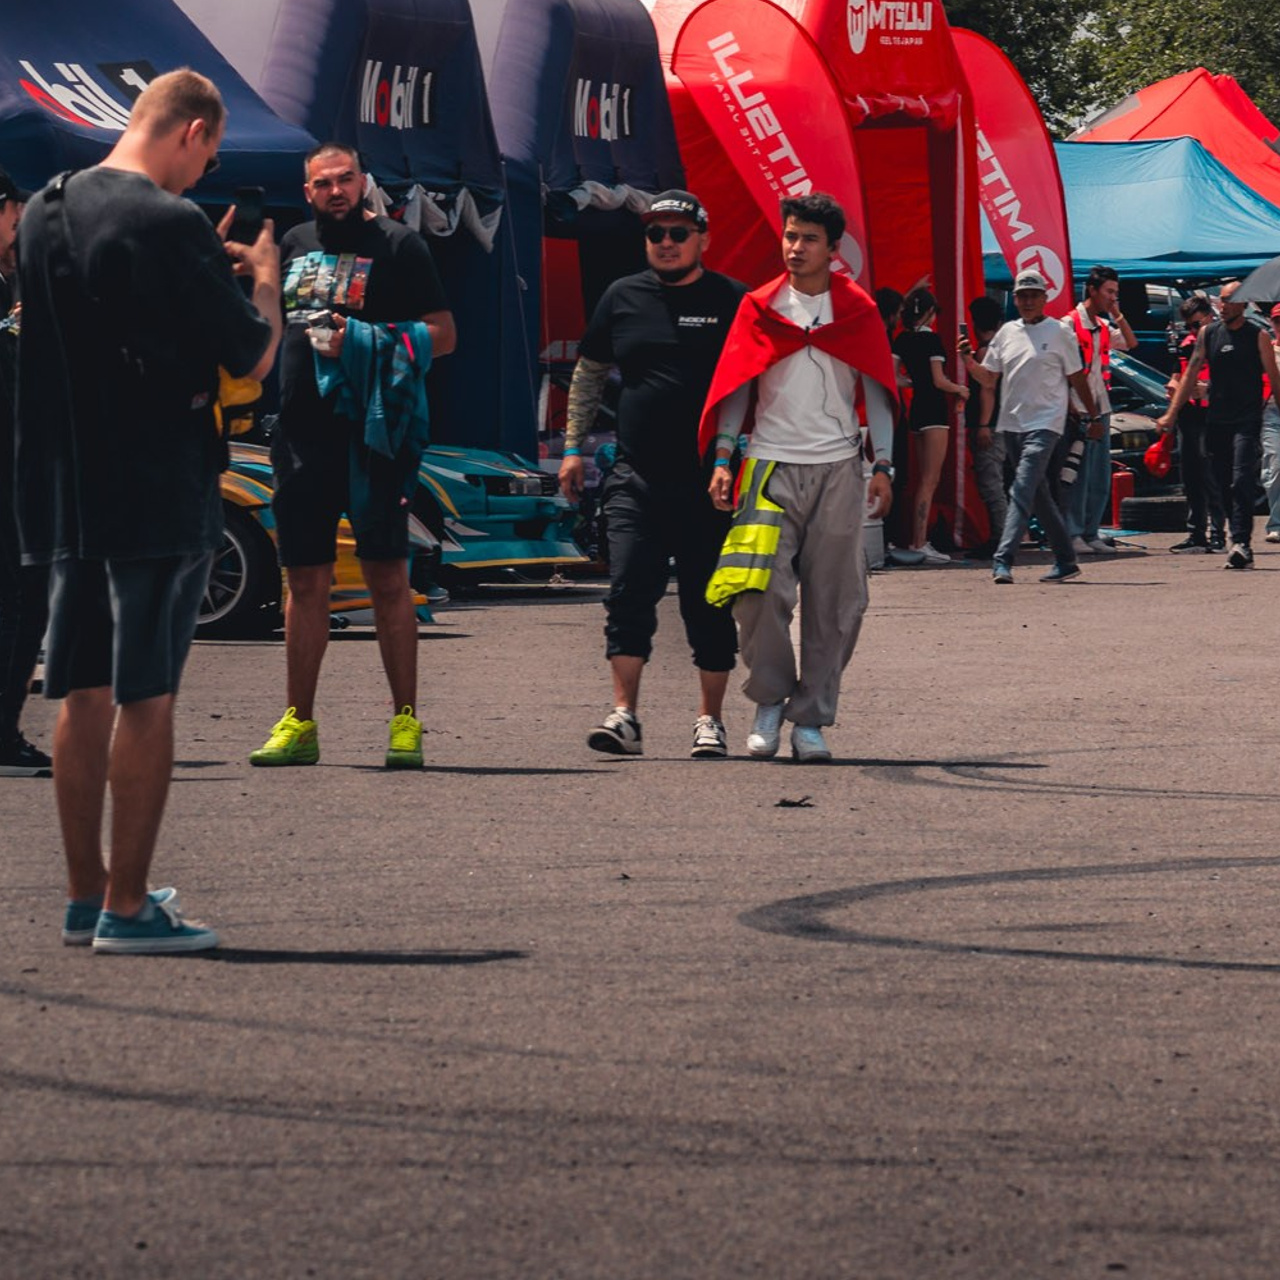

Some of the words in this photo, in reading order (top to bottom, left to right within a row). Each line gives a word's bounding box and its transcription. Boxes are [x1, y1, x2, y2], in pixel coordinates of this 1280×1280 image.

[19, 60, 132, 130] obil
[360, 60, 419, 130] Mobil
[423, 71, 433, 123] 1
[575, 78, 620, 141] Mobil
[623, 88, 631, 135] 1
